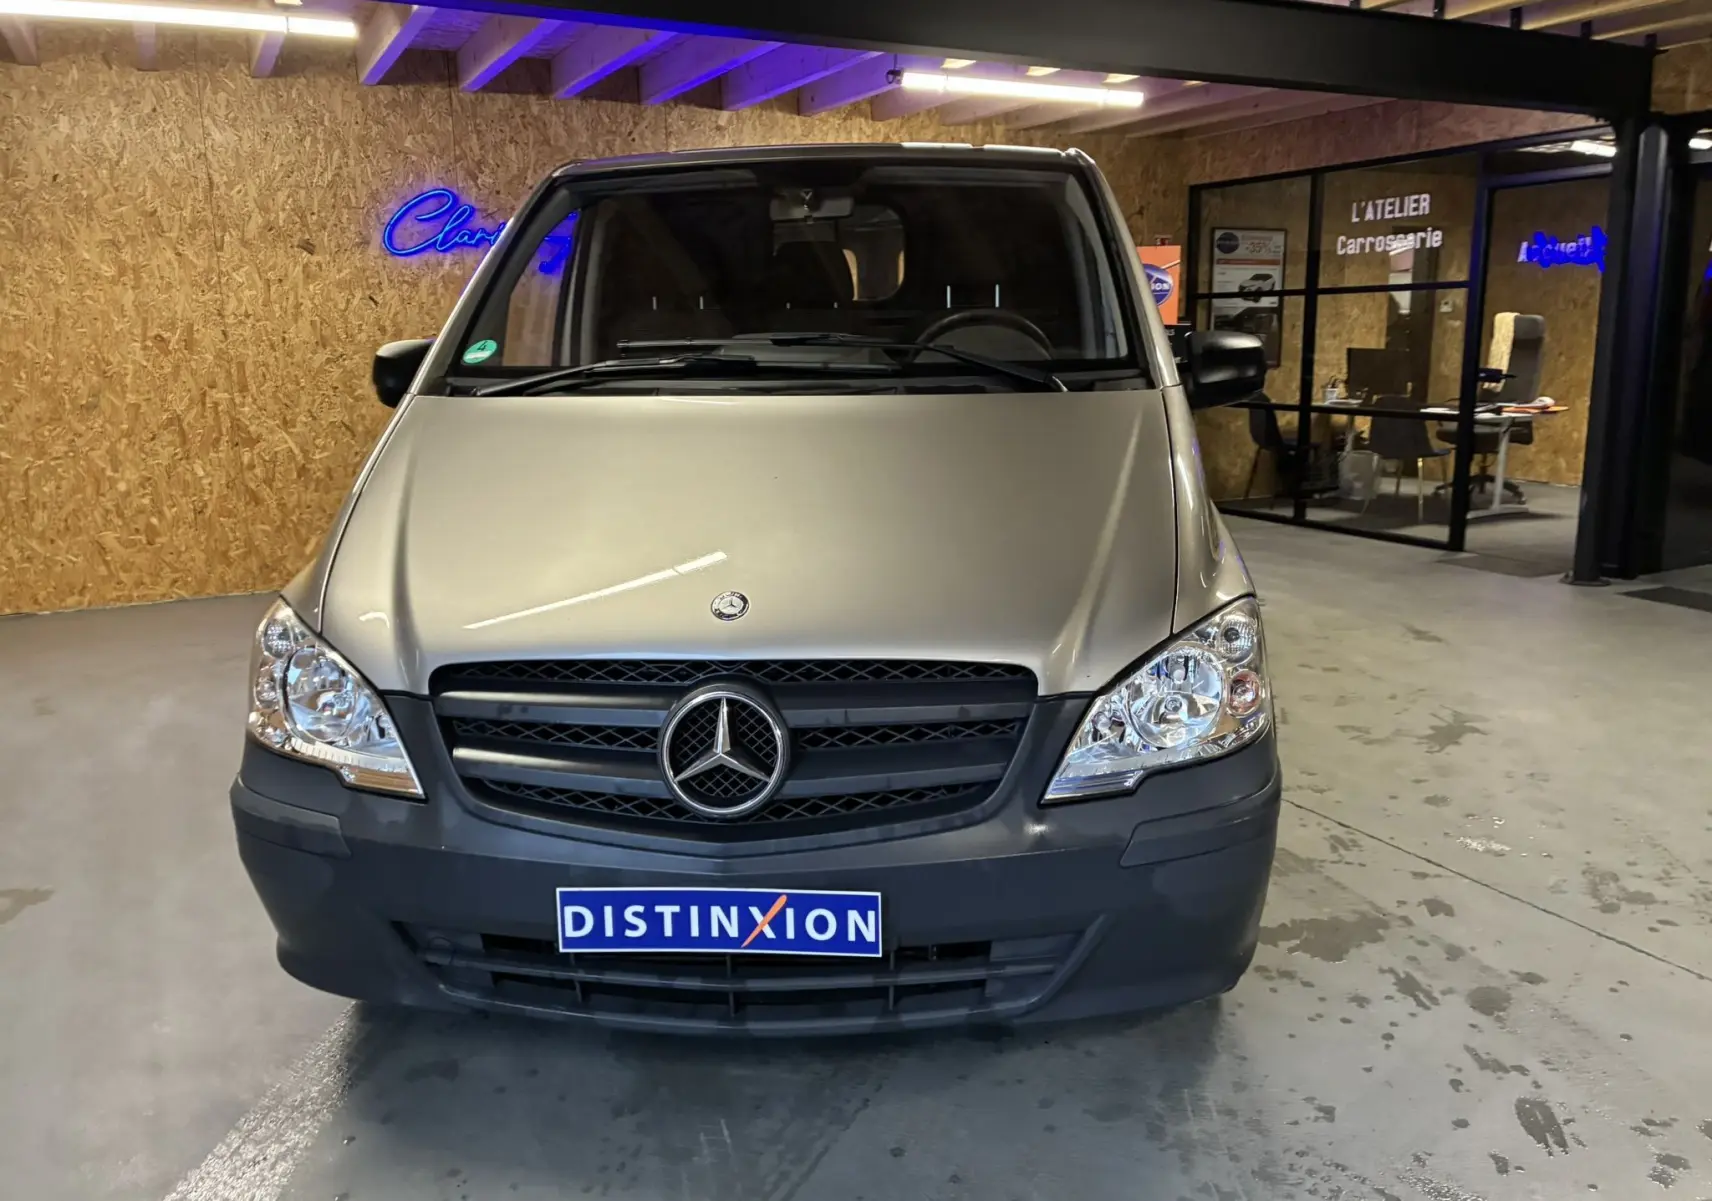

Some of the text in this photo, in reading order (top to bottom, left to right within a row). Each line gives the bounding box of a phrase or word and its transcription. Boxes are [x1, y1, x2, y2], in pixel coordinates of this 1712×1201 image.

[1351, 194, 1430, 222] L'ATELIER
[1337, 227, 1442, 254] Carrosserie
[563, 895, 876, 947] DISTINXION
